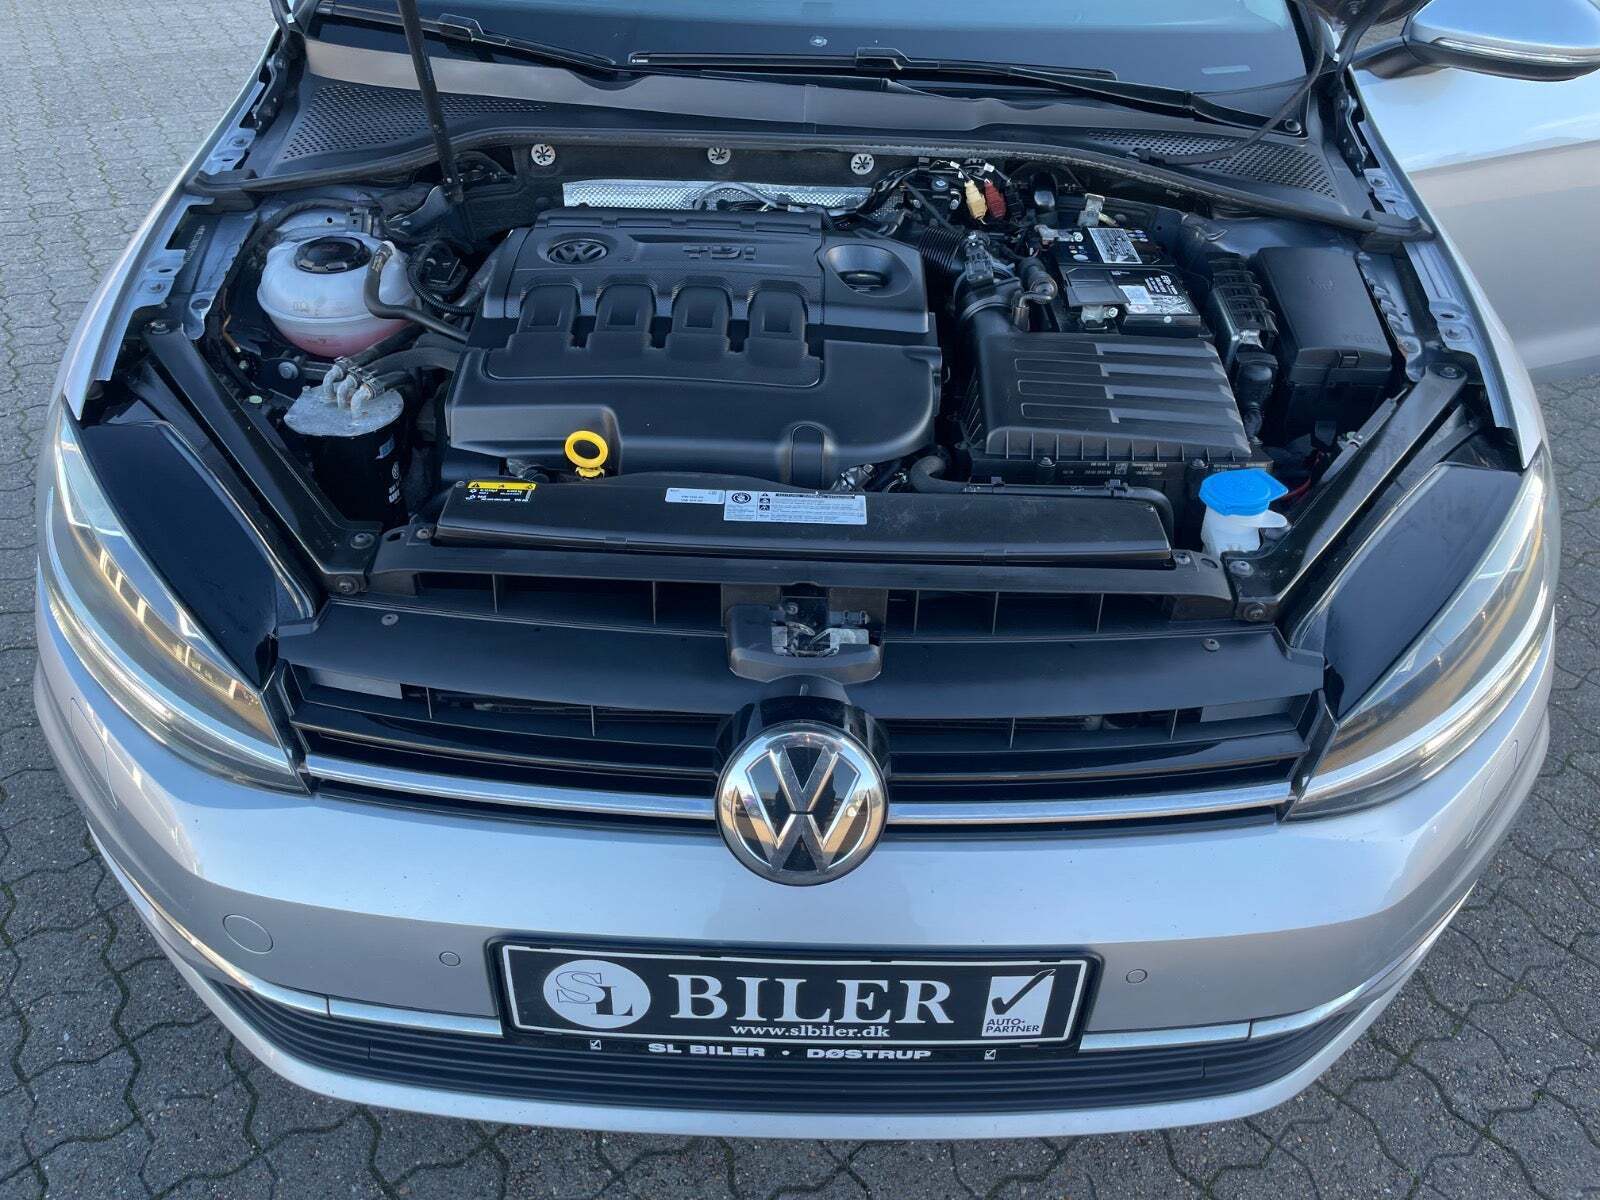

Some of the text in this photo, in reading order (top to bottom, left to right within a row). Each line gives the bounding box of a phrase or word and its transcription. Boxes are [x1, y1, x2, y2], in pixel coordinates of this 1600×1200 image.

[725, 736, 877, 877] VW
[556, 970, 954, 1024] SL BILER
[986, 1025, 1040, 1033] PARTNER
[987, 1018, 1025, 1026] AUTO-
[731, 1024, 891, 1038] www.slbiler.dk
[648, 1043, 931, 1060] SL BILER DØSTRUP
